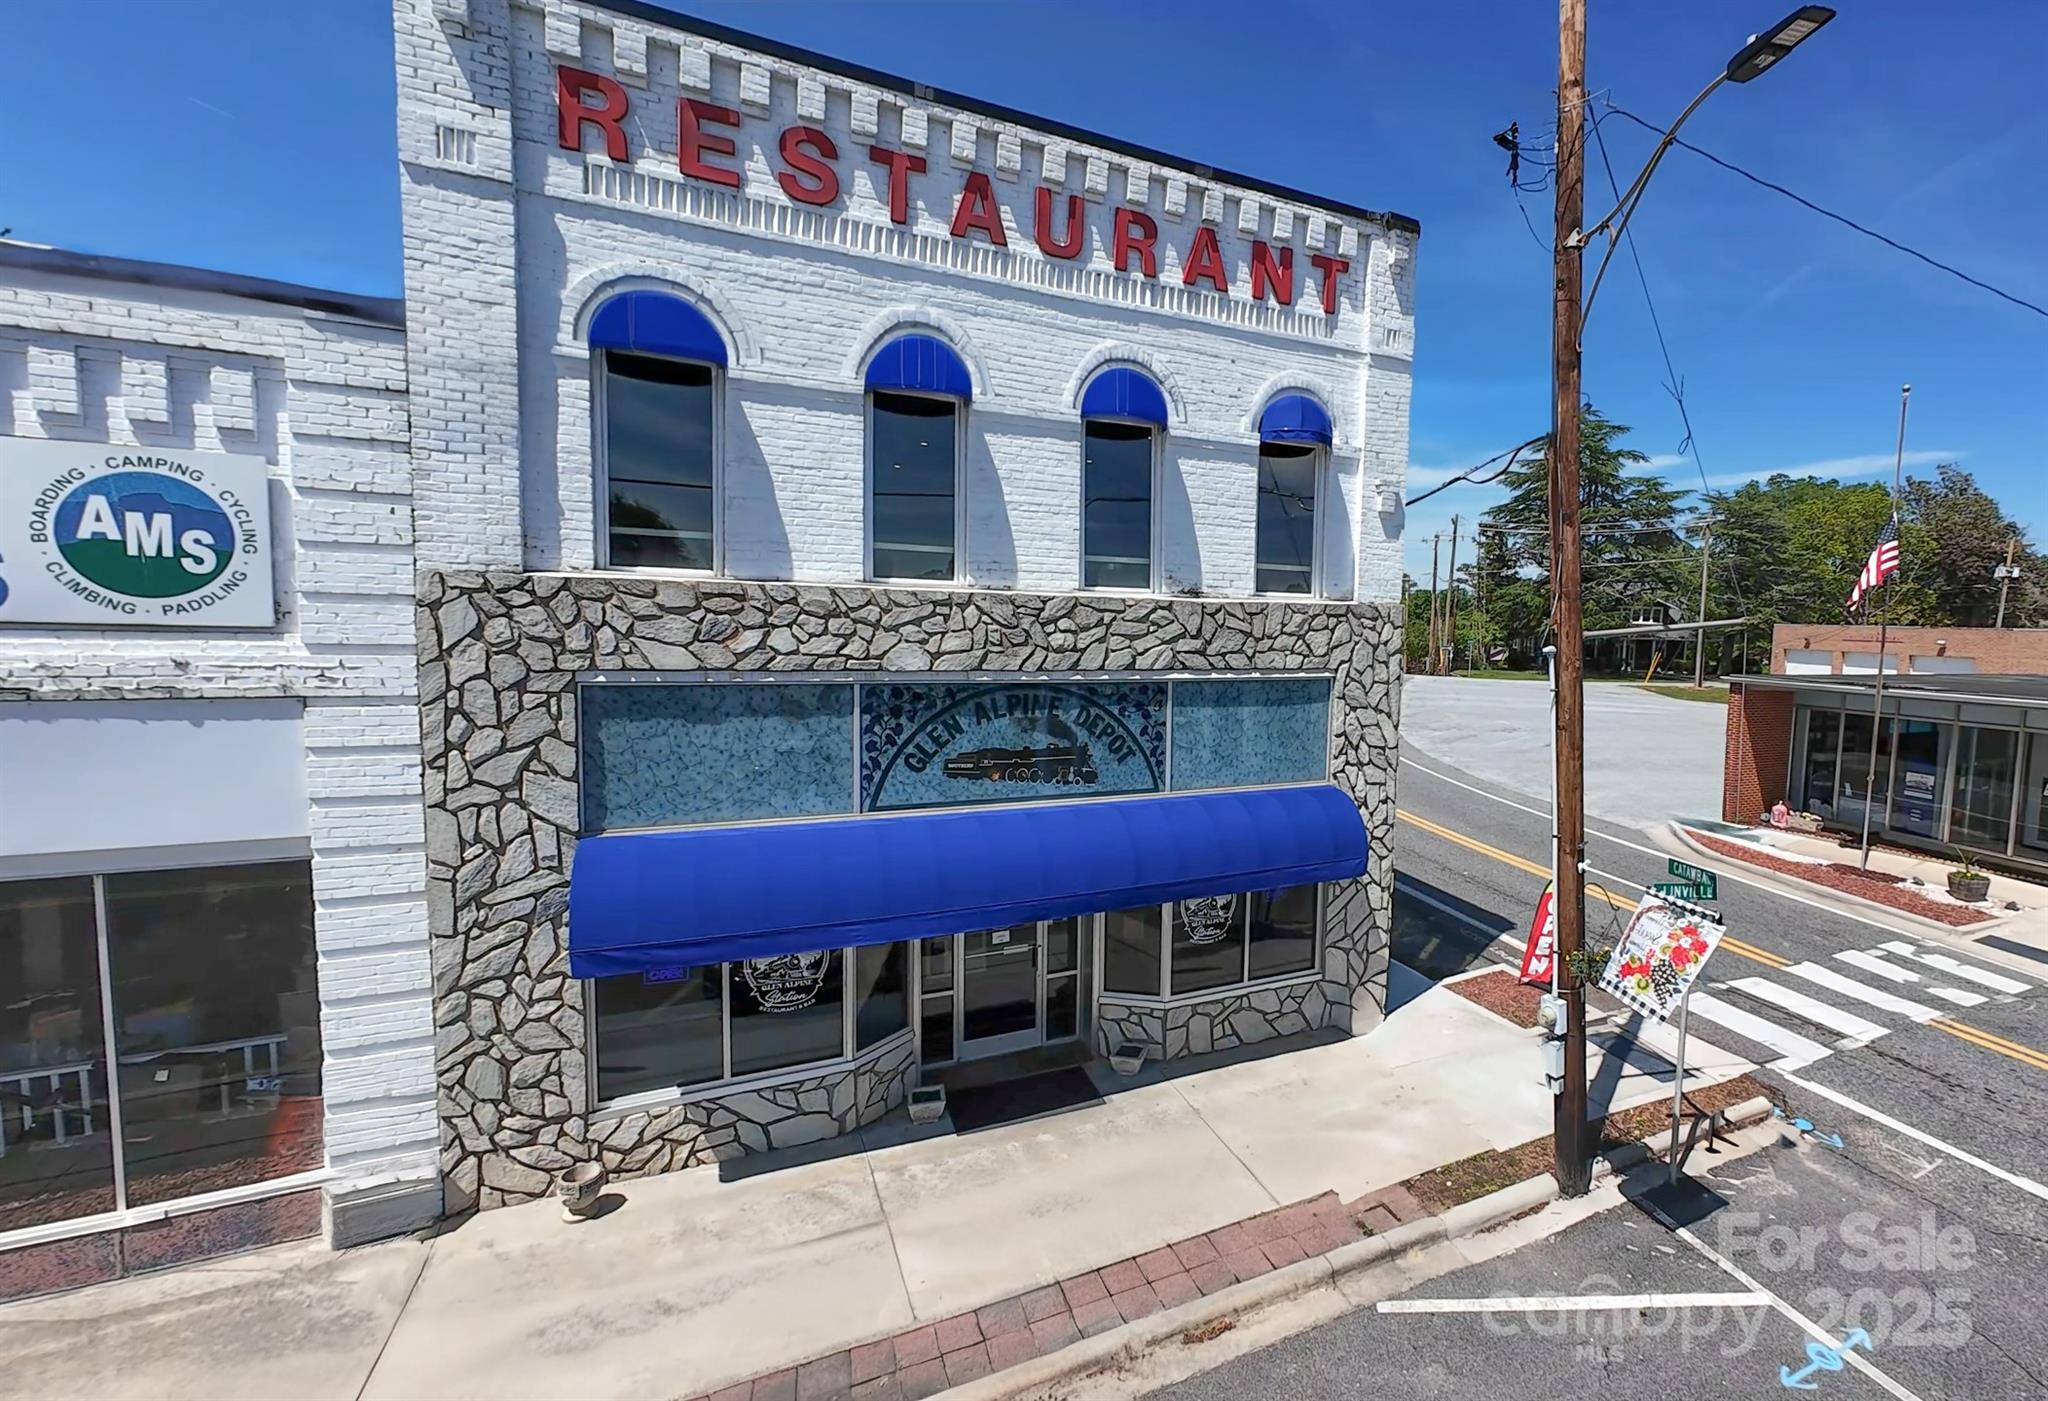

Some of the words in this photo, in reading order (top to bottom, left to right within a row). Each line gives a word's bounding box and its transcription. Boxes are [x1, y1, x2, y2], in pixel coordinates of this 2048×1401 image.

[557, 64, 1350, 315] RESTAURANT
[29, 466, 86, 543] BOARDING
[104, 455, 205, 483] CAMPING
[218, 489, 258, 555] CYCLING
[75, 494, 218, 576] AMS
[45, 561, 137, 615] CLIMBING
[161, 569, 248, 617] PADDLING
[904, 714, 965, 773] GLEN
[974, 692, 1064, 726] ALPINE
[1073, 705, 1137, 766] DEPOT
[1673, 862, 1712, 886] CATAWBA
[765, 989, 808, 1007] Station
[784, 979, 814, 989] ALPINE
